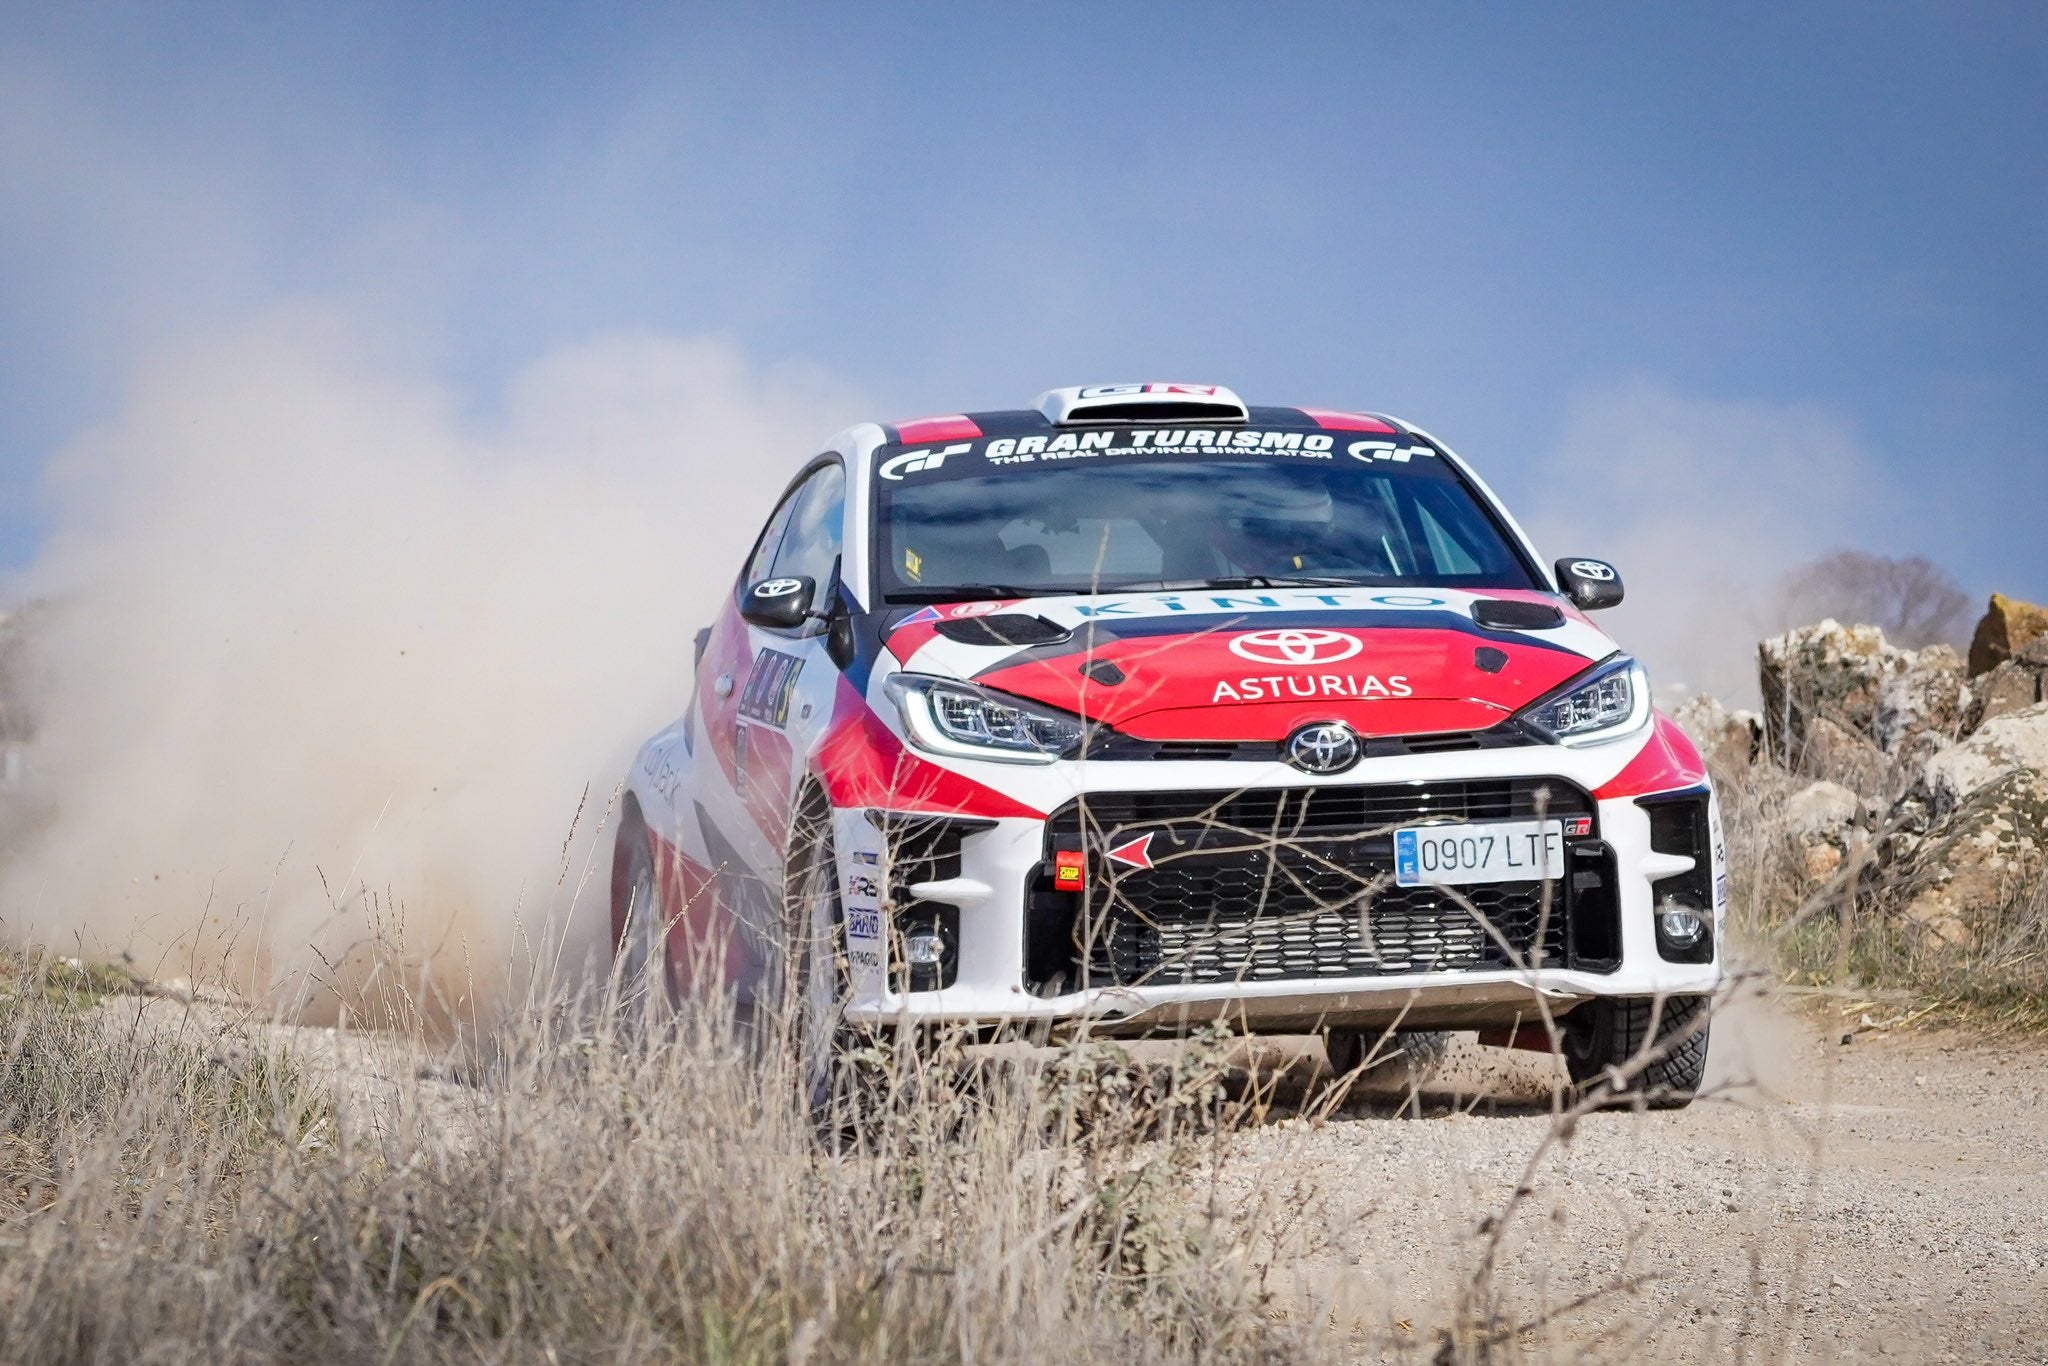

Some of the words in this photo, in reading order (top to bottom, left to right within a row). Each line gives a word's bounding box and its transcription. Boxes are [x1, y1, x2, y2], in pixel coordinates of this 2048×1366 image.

[985, 431, 1115, 458] GRAN
[1130, 429, 1335, 451] TURISMO
[989, 454, 1036, 466] THE
[1041, 449, 1099, 460] REAL
[1105, 446, 1199, 457] DRIVING
[1202, 446, 1333, 459] SIMULATOR
[1212, 675, 1414, 703] ASTURIAS
[1564, 821, 1591, 836] GR
[1422, 836, 1495, 872] 0907
[1506, 832, 1559, 868] LTF
[1403, 862, 1414, 874] E
